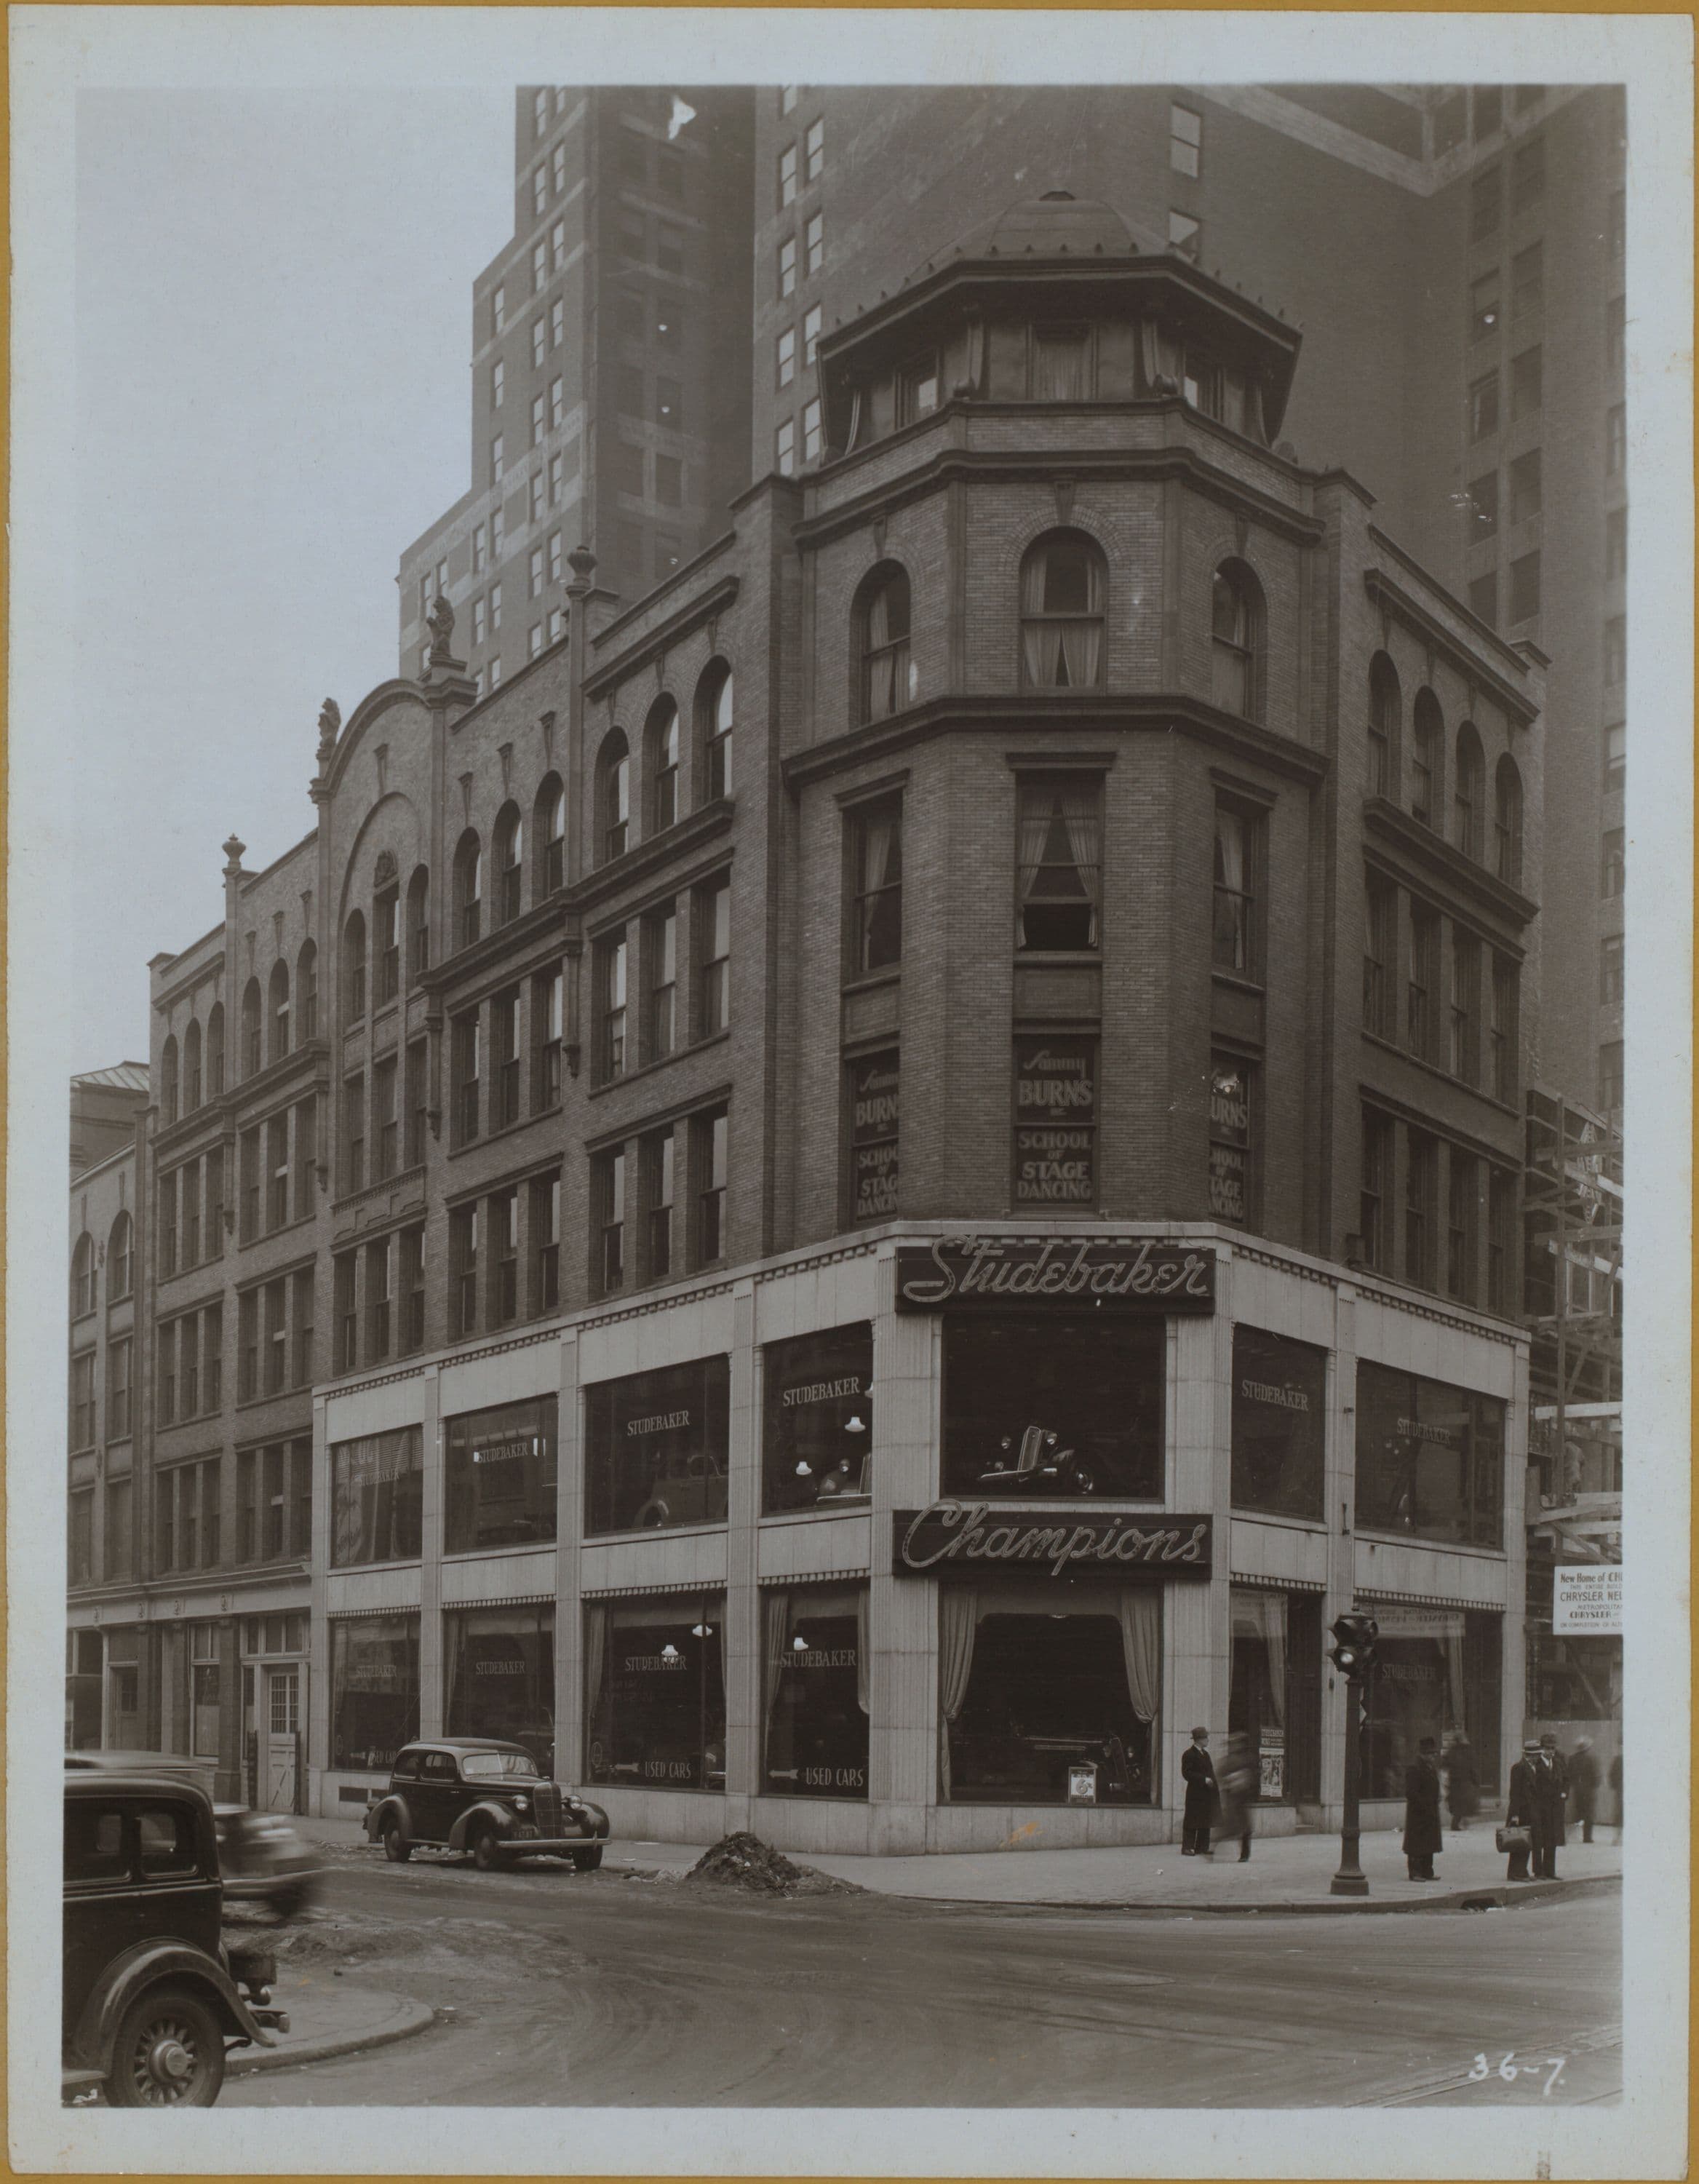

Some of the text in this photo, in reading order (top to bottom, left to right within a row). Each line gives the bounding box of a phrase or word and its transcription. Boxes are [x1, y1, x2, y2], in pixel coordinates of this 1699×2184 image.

[1019, 1079, 1094, 1106] BURNS
[855, 1093, 899, 1127] BURN
[1210, 1095, 1247, 1129] URNS
[1019, 1131, 1091, 1150] SCHOOL
[859, 1145, 899, 1168] SCHOO
[1046, 1149, 1066, 1160] OF
[1211, 1145, 1244, 1171] HOOL
[1022, 1161, 1089, 1180] STAGE
[861, 1173, 898, 1198] STAG
[1019, 1180, 1091, 1200] DANCING
[1211, 1175, 1241, 1200] TAGE
[1209, 1194, 1244, 1220] NCING
[903, 1234, 1208, 1303] Studebaker
[782, 1375, 861, 1407] STUDEBAKER
[1241, 1378, 1310, 1413] STUDEBAKER
[626, 1409, 691, 1437] STUDEBAKER
[1397, 1416, 1450, 1445] STUDEBAKER
[478, 1442, 529, 1464] STUDEBAKER
[902, 1498, 1208, 1576] Champions
[1560, 1573, 1575, 1583] New
[1576, 1572, 1596, 1583] Home
[1596, 1571, 1606, 1582] of
[1560, 1591, 1604, 1602] CHRYSLER
[1569, 1611, 1612, 1619] CHRYSLER
[475, 1660, 525, 1675] STUDEBAKER
[624, 1654, 688, 1672] STUDEBAKER
[779, 1649, 856, 1669] STUDEBAKER
[645, 1760, 692, 1779] USED CARS
[805, 1766, 864, 1787] USED CARS
